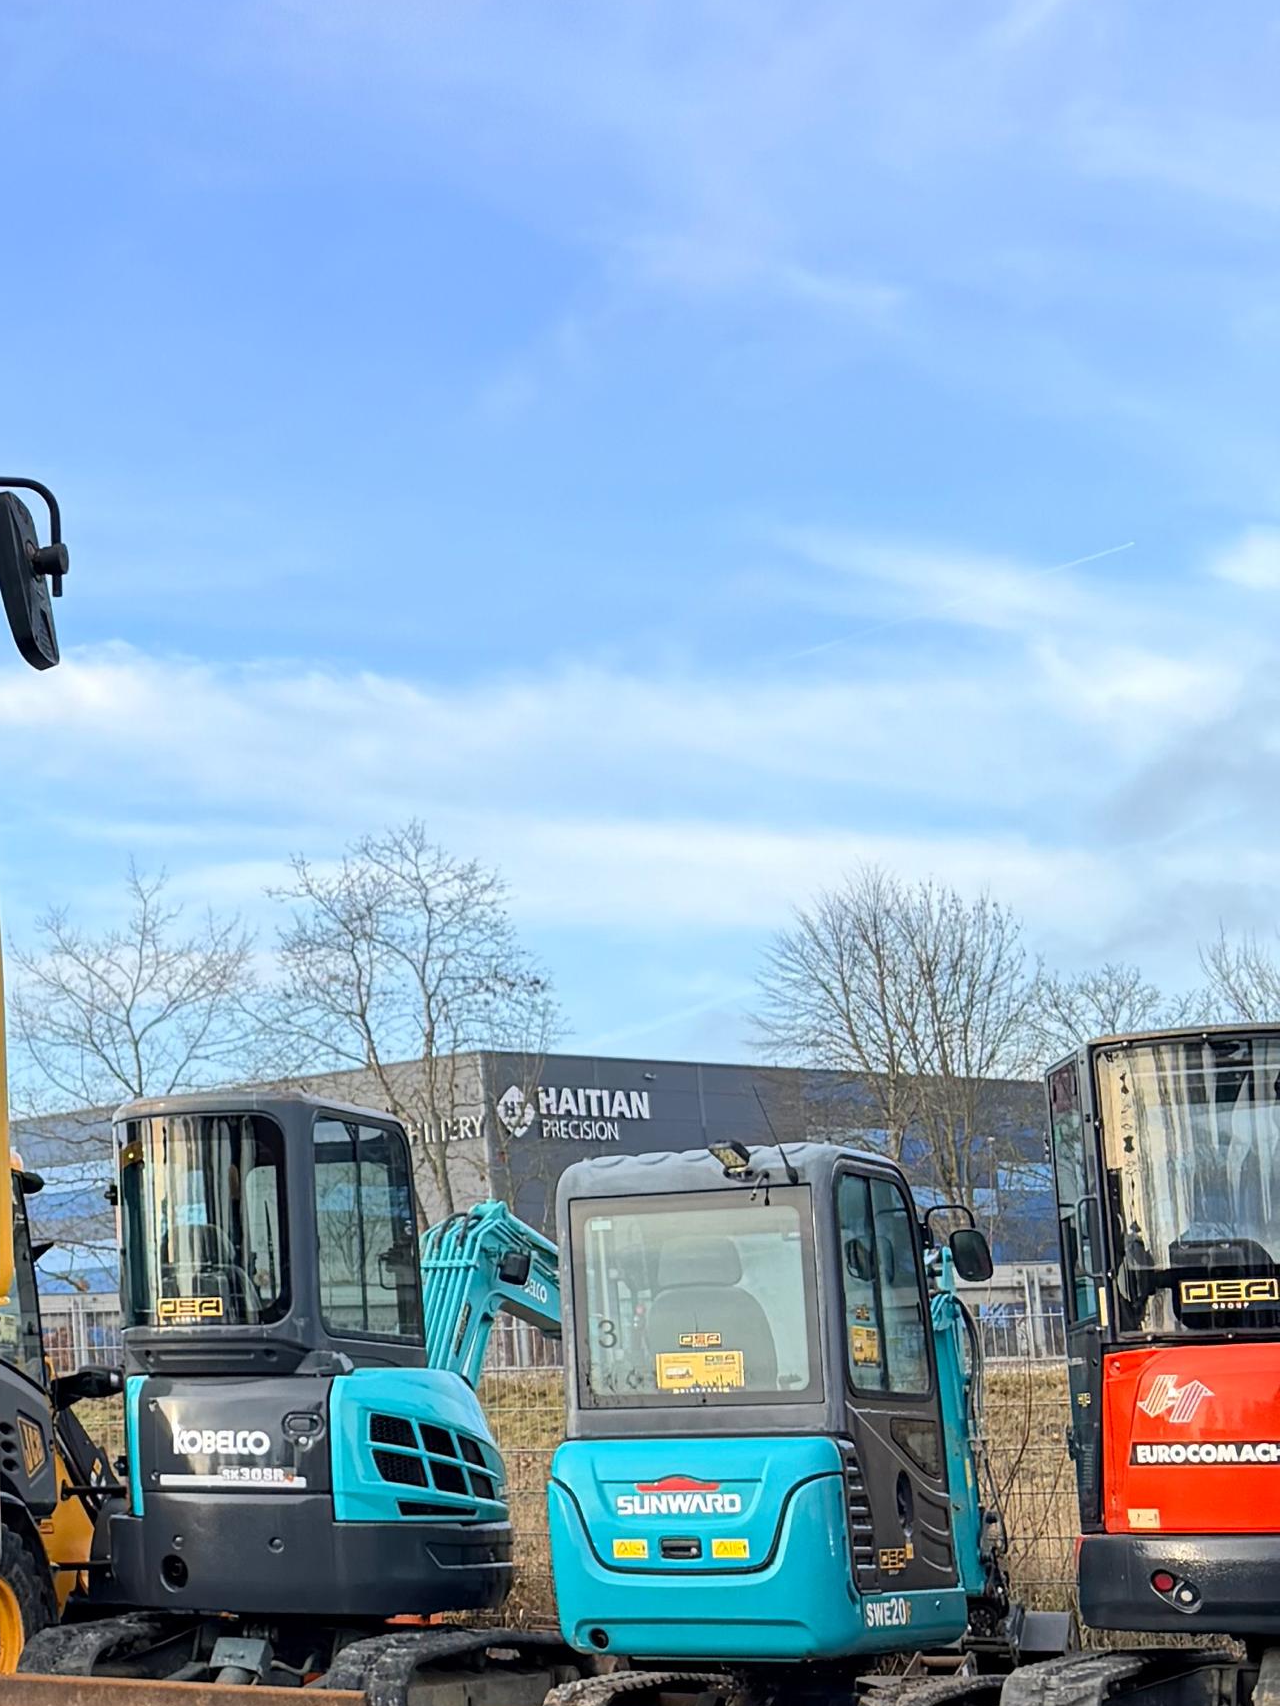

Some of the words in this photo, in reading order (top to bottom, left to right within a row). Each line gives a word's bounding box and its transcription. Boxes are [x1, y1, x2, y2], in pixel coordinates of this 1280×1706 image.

[538, 1086, 651, 1120] HAITIAN
[542, 1119, 620, 1141] PRECISION
[598, 1319, 618, 1349] 3
[172, 1422, 271, 1456] KOBELCO
[616, 1493, 742, 1516] SUNWARD
